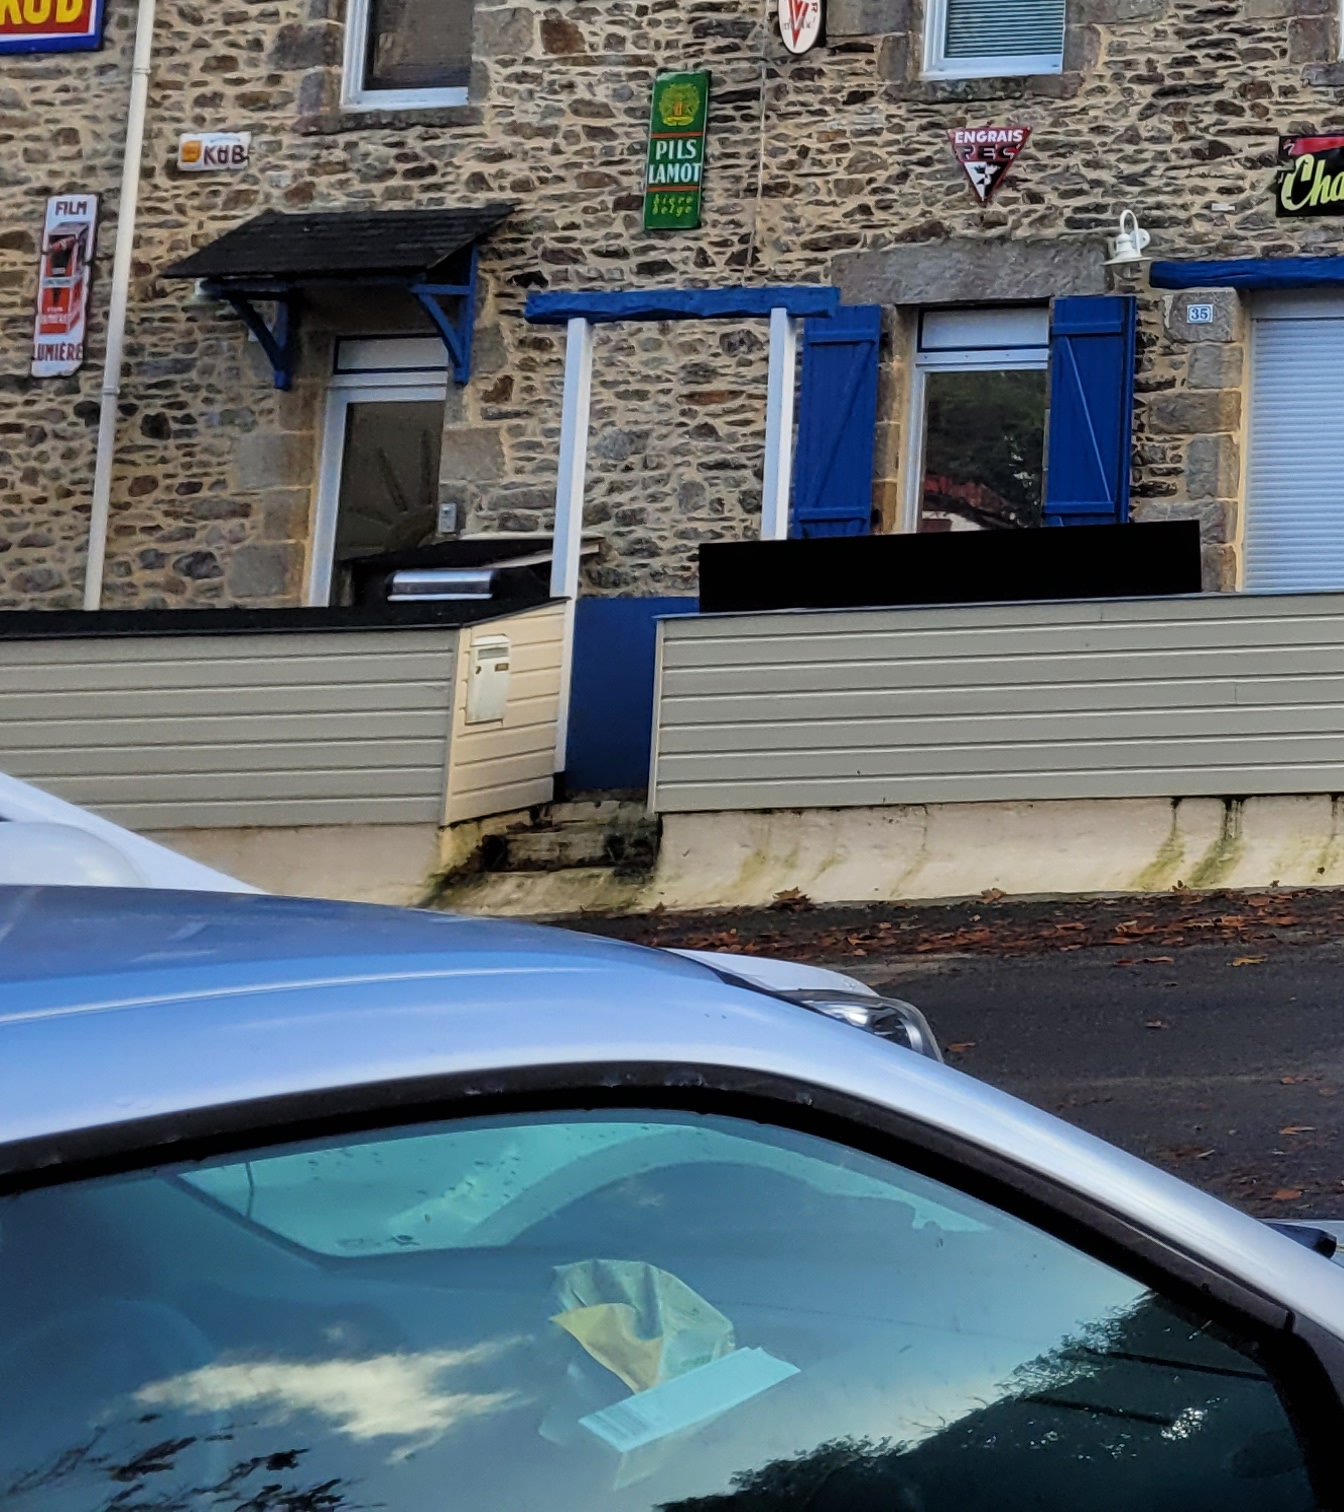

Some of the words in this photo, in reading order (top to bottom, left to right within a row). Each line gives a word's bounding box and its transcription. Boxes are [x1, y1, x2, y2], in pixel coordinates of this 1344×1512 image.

[955, 129, 1024, 144] ENGRAIS
[655, 138, 697, 161] PILS
[648, 162, 702, 185] LAMOT
[54, 200, 88, 216] FILM
[1190, 307, 1209, 320] 35
